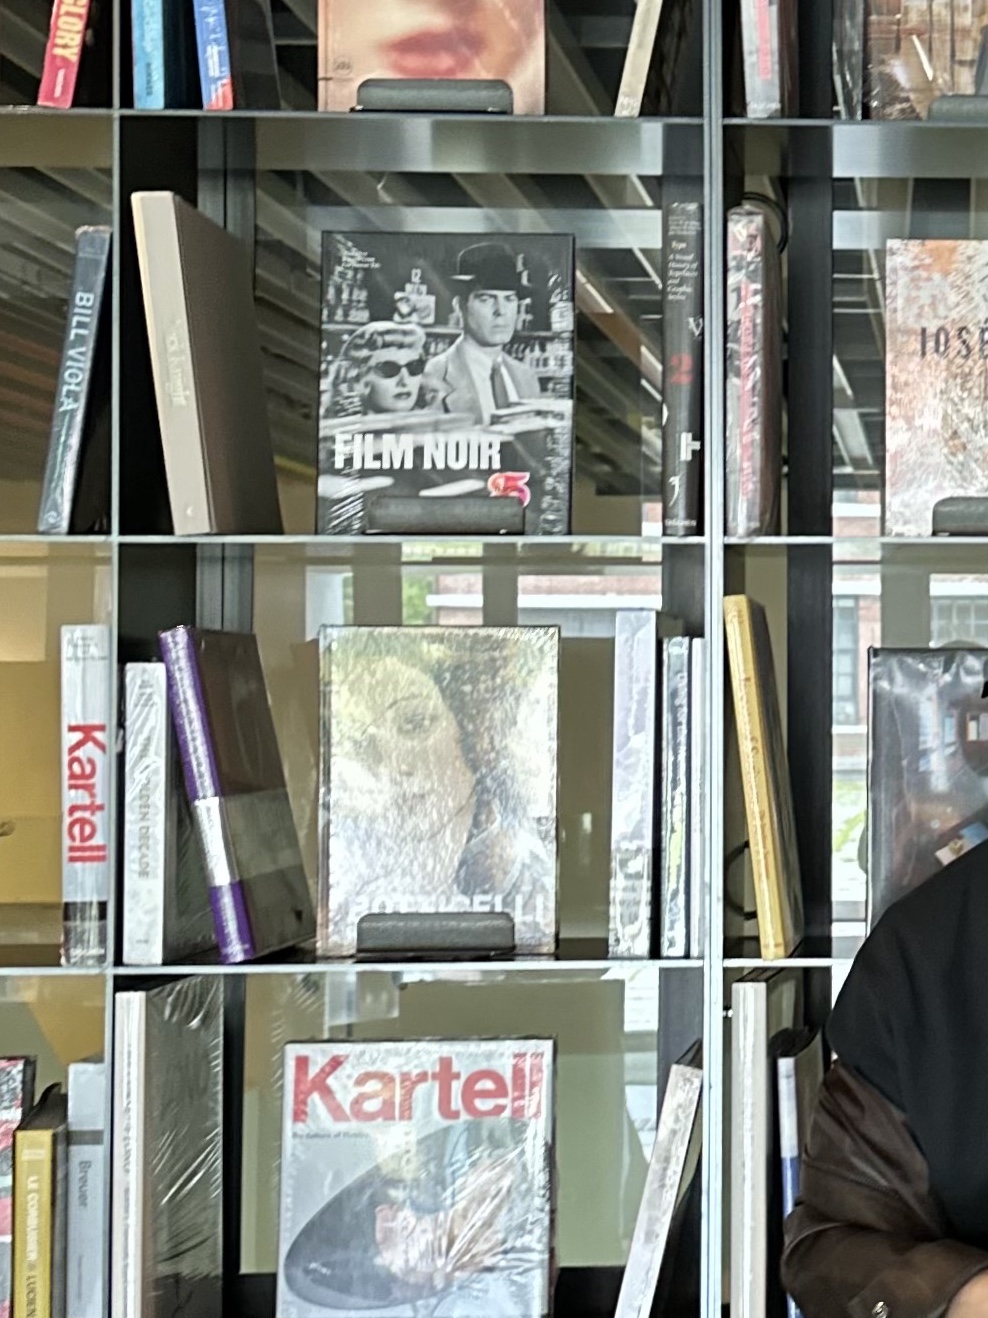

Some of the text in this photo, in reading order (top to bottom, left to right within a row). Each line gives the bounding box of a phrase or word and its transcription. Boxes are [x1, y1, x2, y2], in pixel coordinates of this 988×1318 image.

[59, 290, 94, 411] BILL VIOLA
[333, 432, 502, 470] FILM NOIR
[66, 723, 107, 864] Kartell
[138, 826, 151, 879] DECADE
[293, 1052, 545, 1123] Kartell
[26, 1175, 40, 1191] LE
[77, 1159, 92, 1209] Breuer
[24, 1275, 39, 1318] LUCIEN
